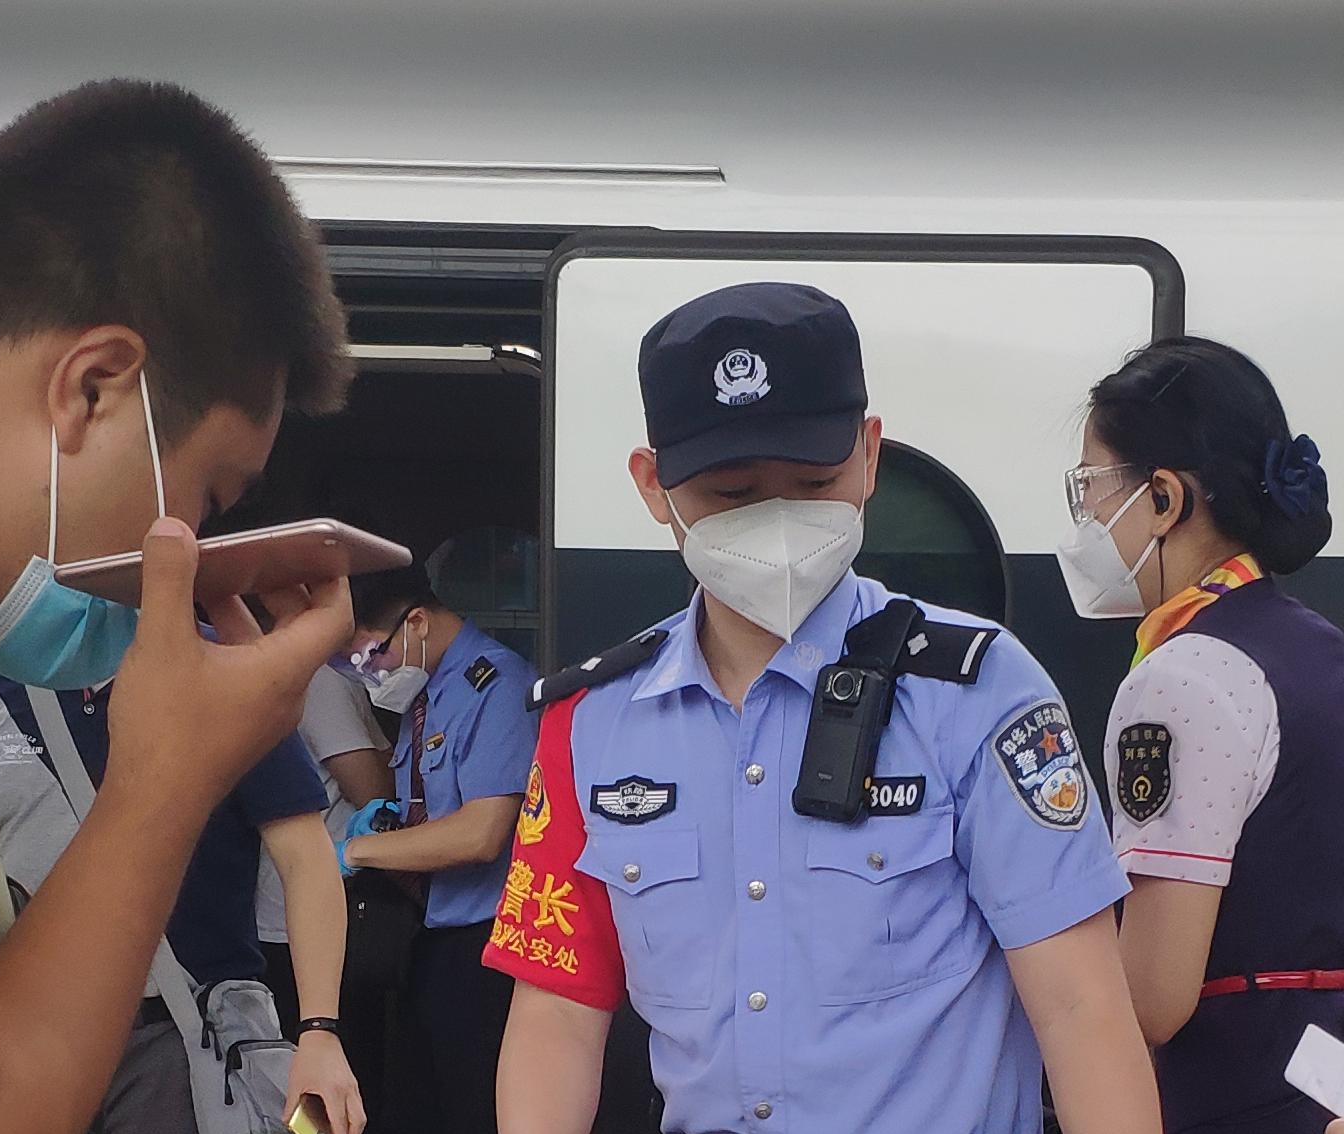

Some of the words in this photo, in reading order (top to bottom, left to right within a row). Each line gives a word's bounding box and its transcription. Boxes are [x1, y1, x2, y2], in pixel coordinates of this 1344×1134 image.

[1124, 745, 1162, 761] 列车长
[869, 783, 918, 808] 3040
[501, 859, 580, 936] 警长
